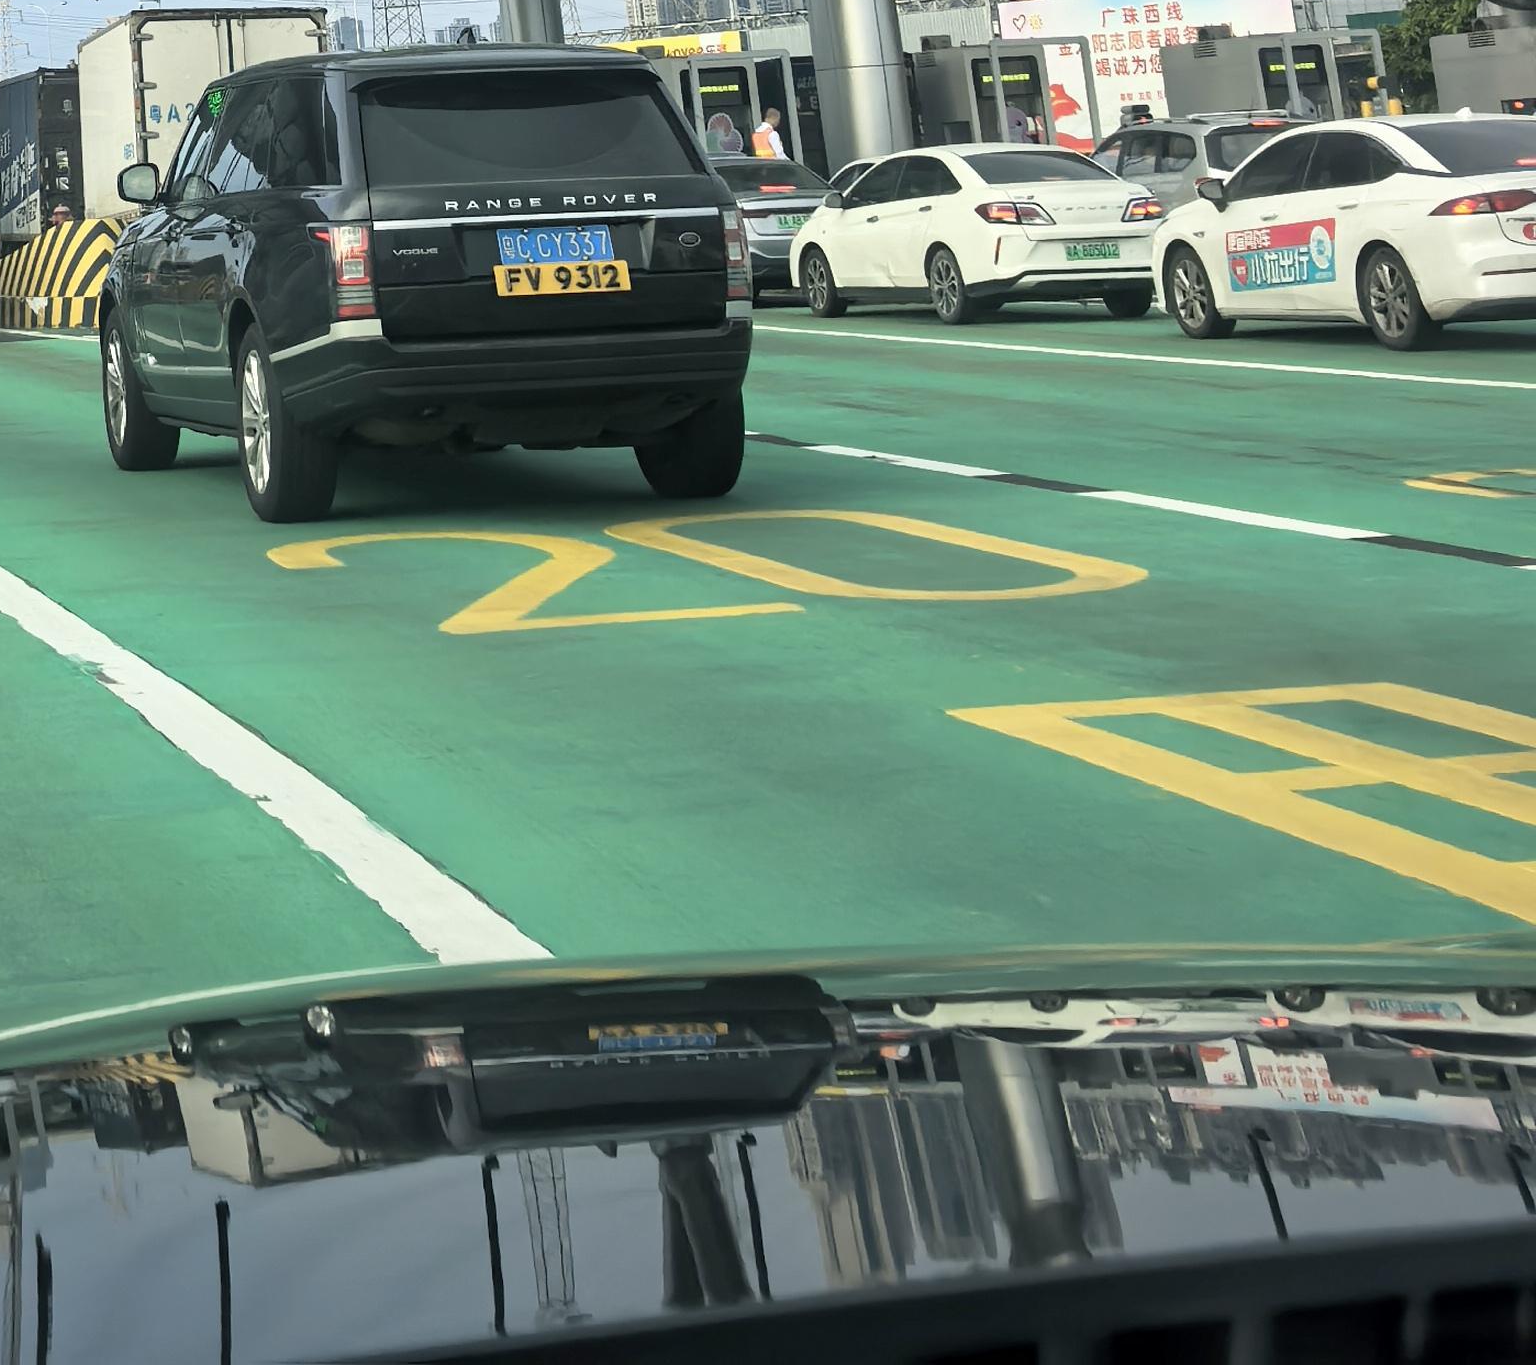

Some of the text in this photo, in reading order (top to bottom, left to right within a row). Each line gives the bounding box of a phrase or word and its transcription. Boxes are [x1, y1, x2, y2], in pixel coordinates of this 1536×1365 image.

[1101, 1, 1184, 28] 广珠西线
[445, 192, 659, 211] RANGE ROVER
[392, 246, 439, 256] VOGUE
[504, 264, 621, 293] FV 9312
[1252, 246, 1310, 285] 小拉出行
[267, 508, 1148, 635] 20
